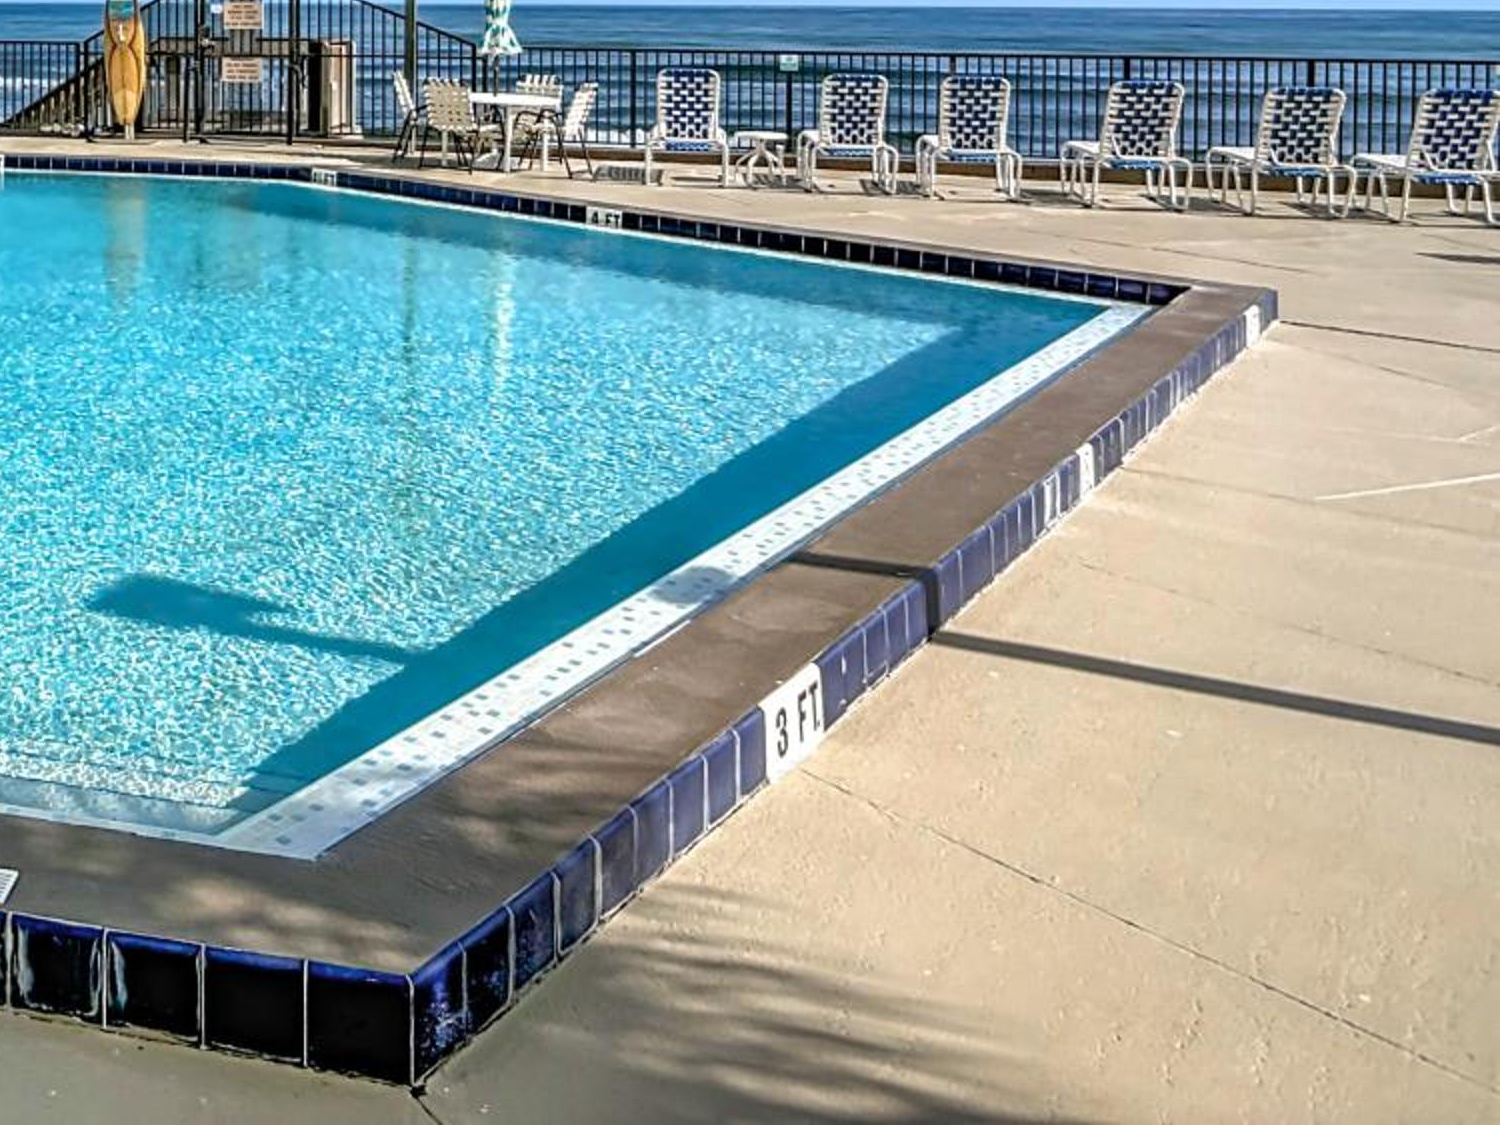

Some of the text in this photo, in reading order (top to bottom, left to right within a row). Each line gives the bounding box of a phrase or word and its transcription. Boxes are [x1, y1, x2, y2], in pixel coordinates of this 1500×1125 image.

[591, 210, 620, 228] 4 FT
[775, 706, 789, 759] 3
